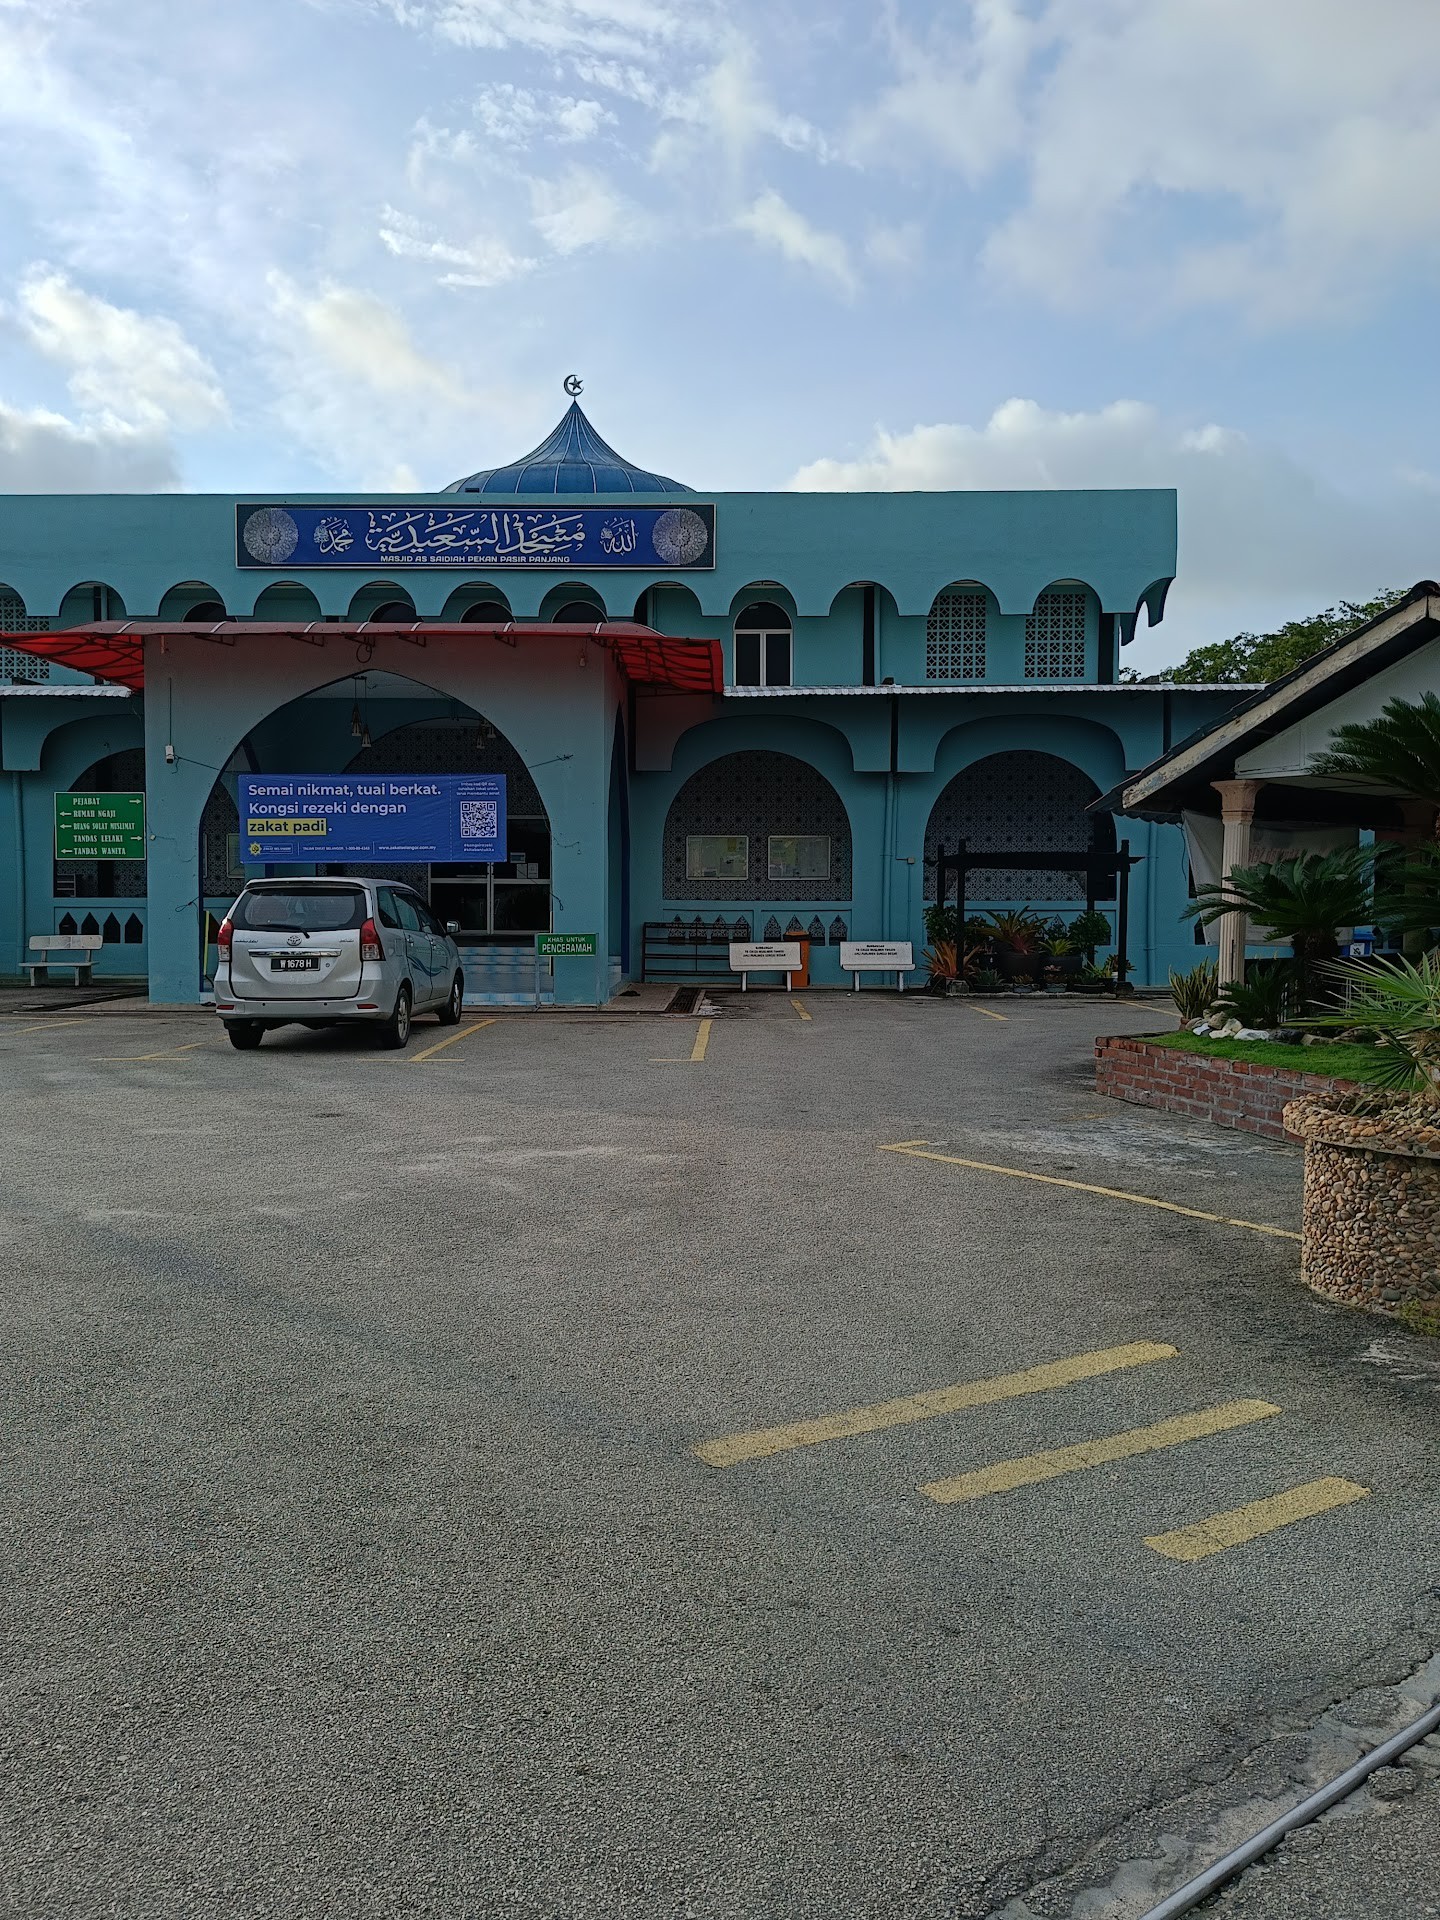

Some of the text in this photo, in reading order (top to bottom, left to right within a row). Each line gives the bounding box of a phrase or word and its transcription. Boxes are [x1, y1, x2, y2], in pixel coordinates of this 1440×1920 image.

[380, 555, 570, 563] MASJID AS SAIDIAH PEKAN PASIR PANJANG
[248, 783, 441, 797] Semai nikmat, tuai berkat.
[72, 798, 100, 806] PEJABAT
[249, 801, 407, 816] Kongsi rezeki dengan
[73, 810, 116, 818] RUMAH NGAJI
[249, 821, 289, 832] zakat
[73, 834, 98, 842] TANDAS
[73, 847, 98, 855] TANDAS
[542, 944, 592, 953] PENCERAMAH
[280, 959, 312, 968] W 1678 H
